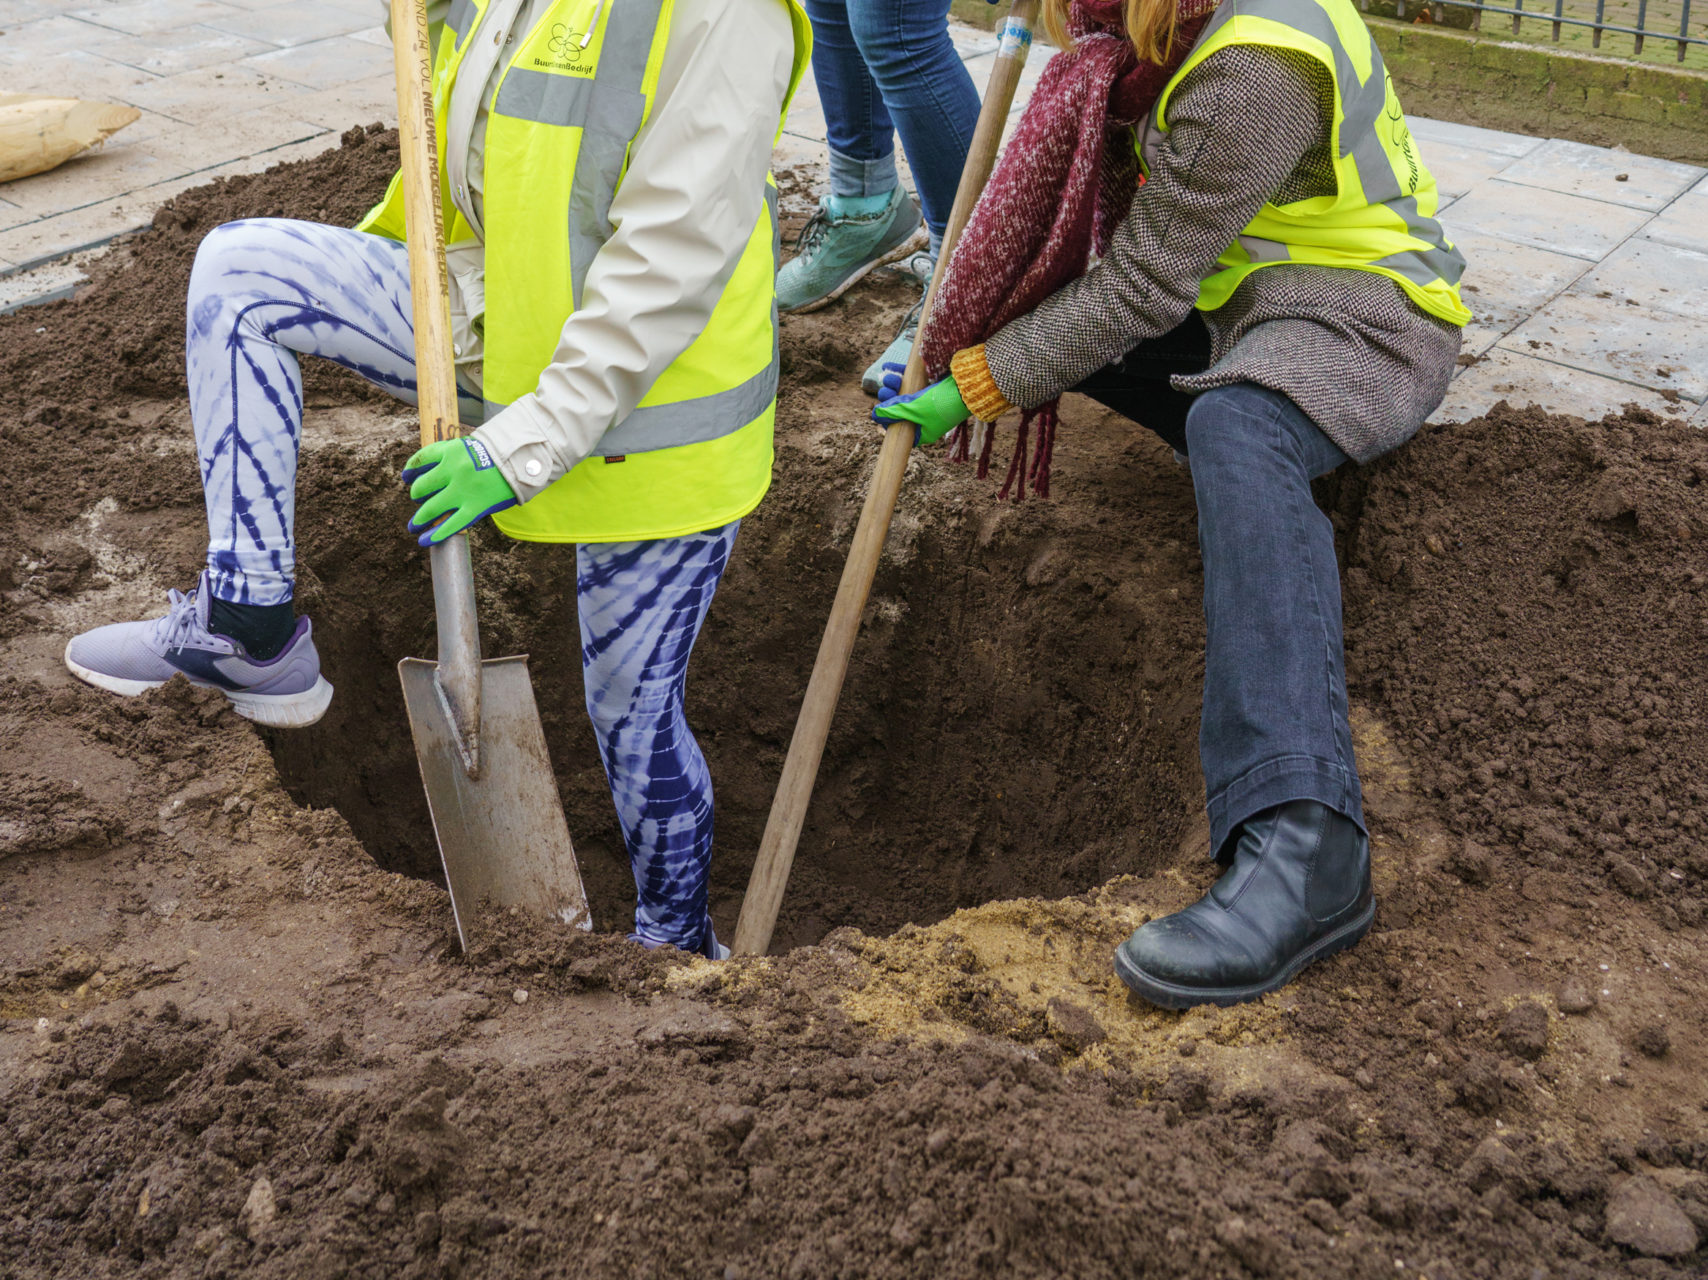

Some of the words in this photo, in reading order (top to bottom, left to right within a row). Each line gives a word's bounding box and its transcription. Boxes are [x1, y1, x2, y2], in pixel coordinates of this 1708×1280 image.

[419, 58, 432, 87] VOL
[422, 91, 438, 154] NIEUWE
[428, 157, 449, 297] MOGELIJKHEDEN
